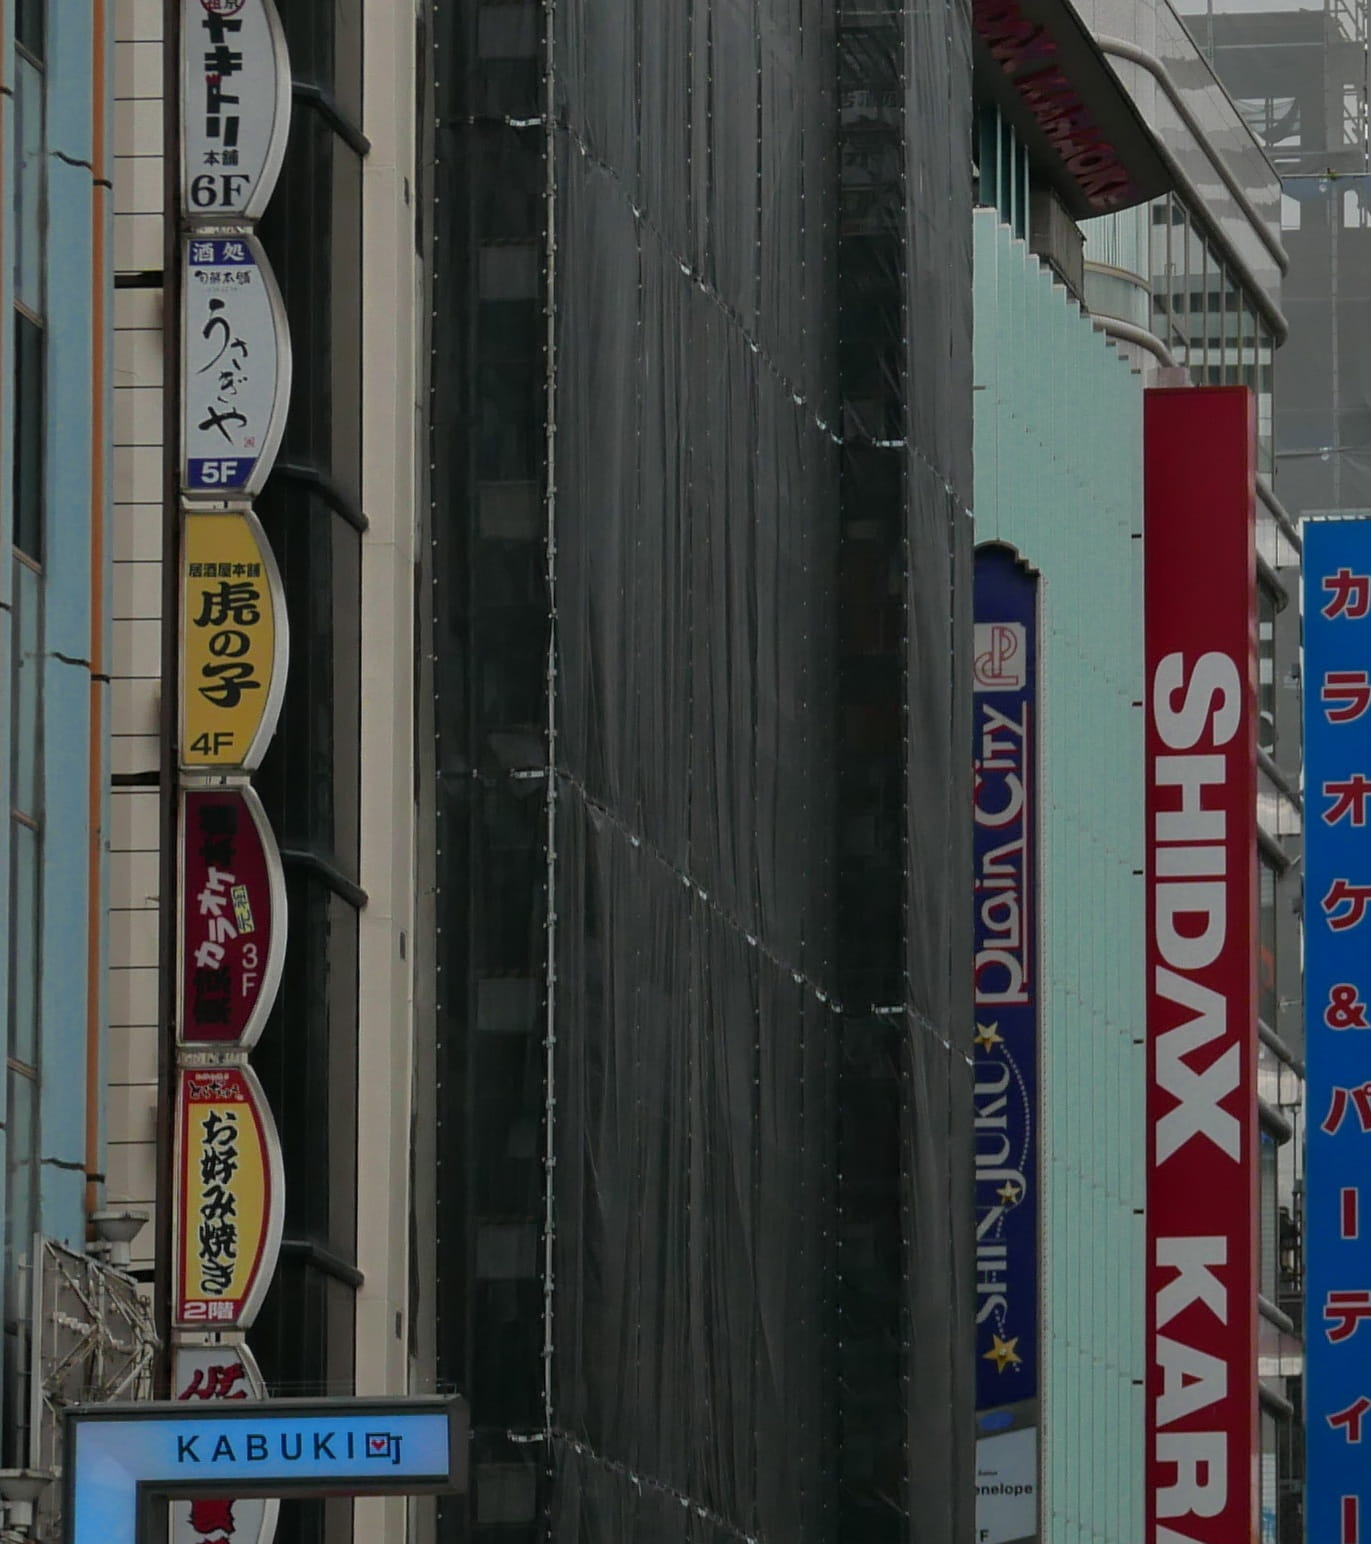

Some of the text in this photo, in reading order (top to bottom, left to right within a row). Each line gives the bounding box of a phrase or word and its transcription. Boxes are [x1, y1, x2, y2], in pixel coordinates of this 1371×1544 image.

[190, 174, 251, 208] 6F
[193, 243, 246, 262] 酒処
[197, 298, 249, 445] うさぎや
[200, 461, 238, 484] 5F
[192, 581, 261, 708] 虎の子
[190, 732, 234, 756] 4F
[1152, 651, 1242, 1169] SHIDAX
[199, 1110, 238, 1295] お好み焼き
[183, 1301, 234, 1321] 2階
